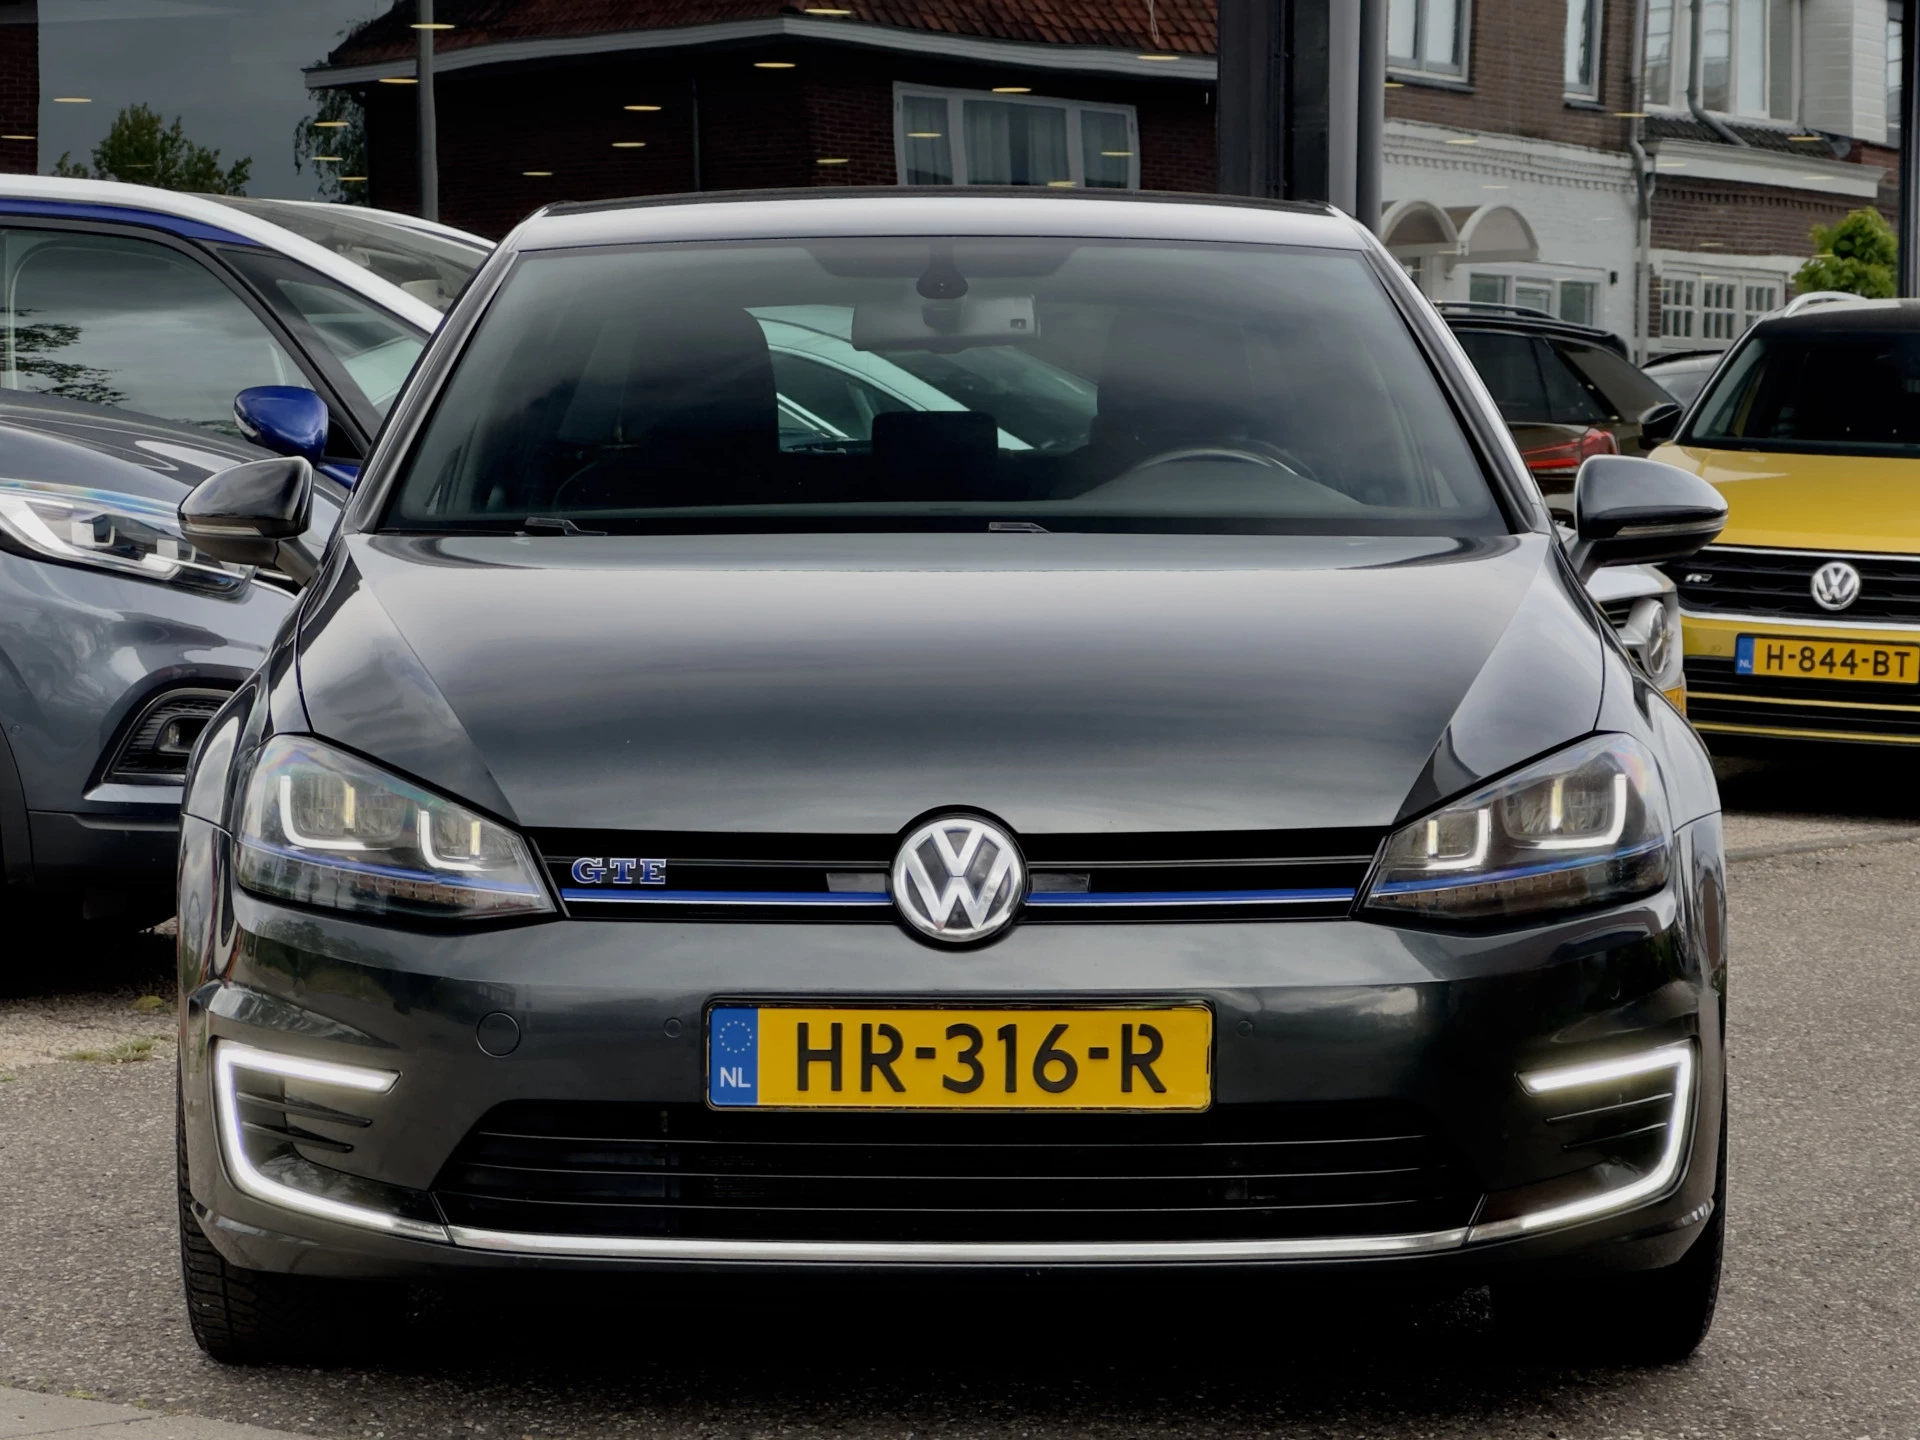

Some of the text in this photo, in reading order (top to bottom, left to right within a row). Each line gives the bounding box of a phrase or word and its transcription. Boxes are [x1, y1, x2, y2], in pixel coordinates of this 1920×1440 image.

[1739, 659, 1752, 668] NL
[1766, 644, 1910, 677] H-844-BT
[571, 857, 667, 885] GTE
[797, 1022, 1167, 1094] HR-316-R
[719, 1067, 751, 1088] NL
